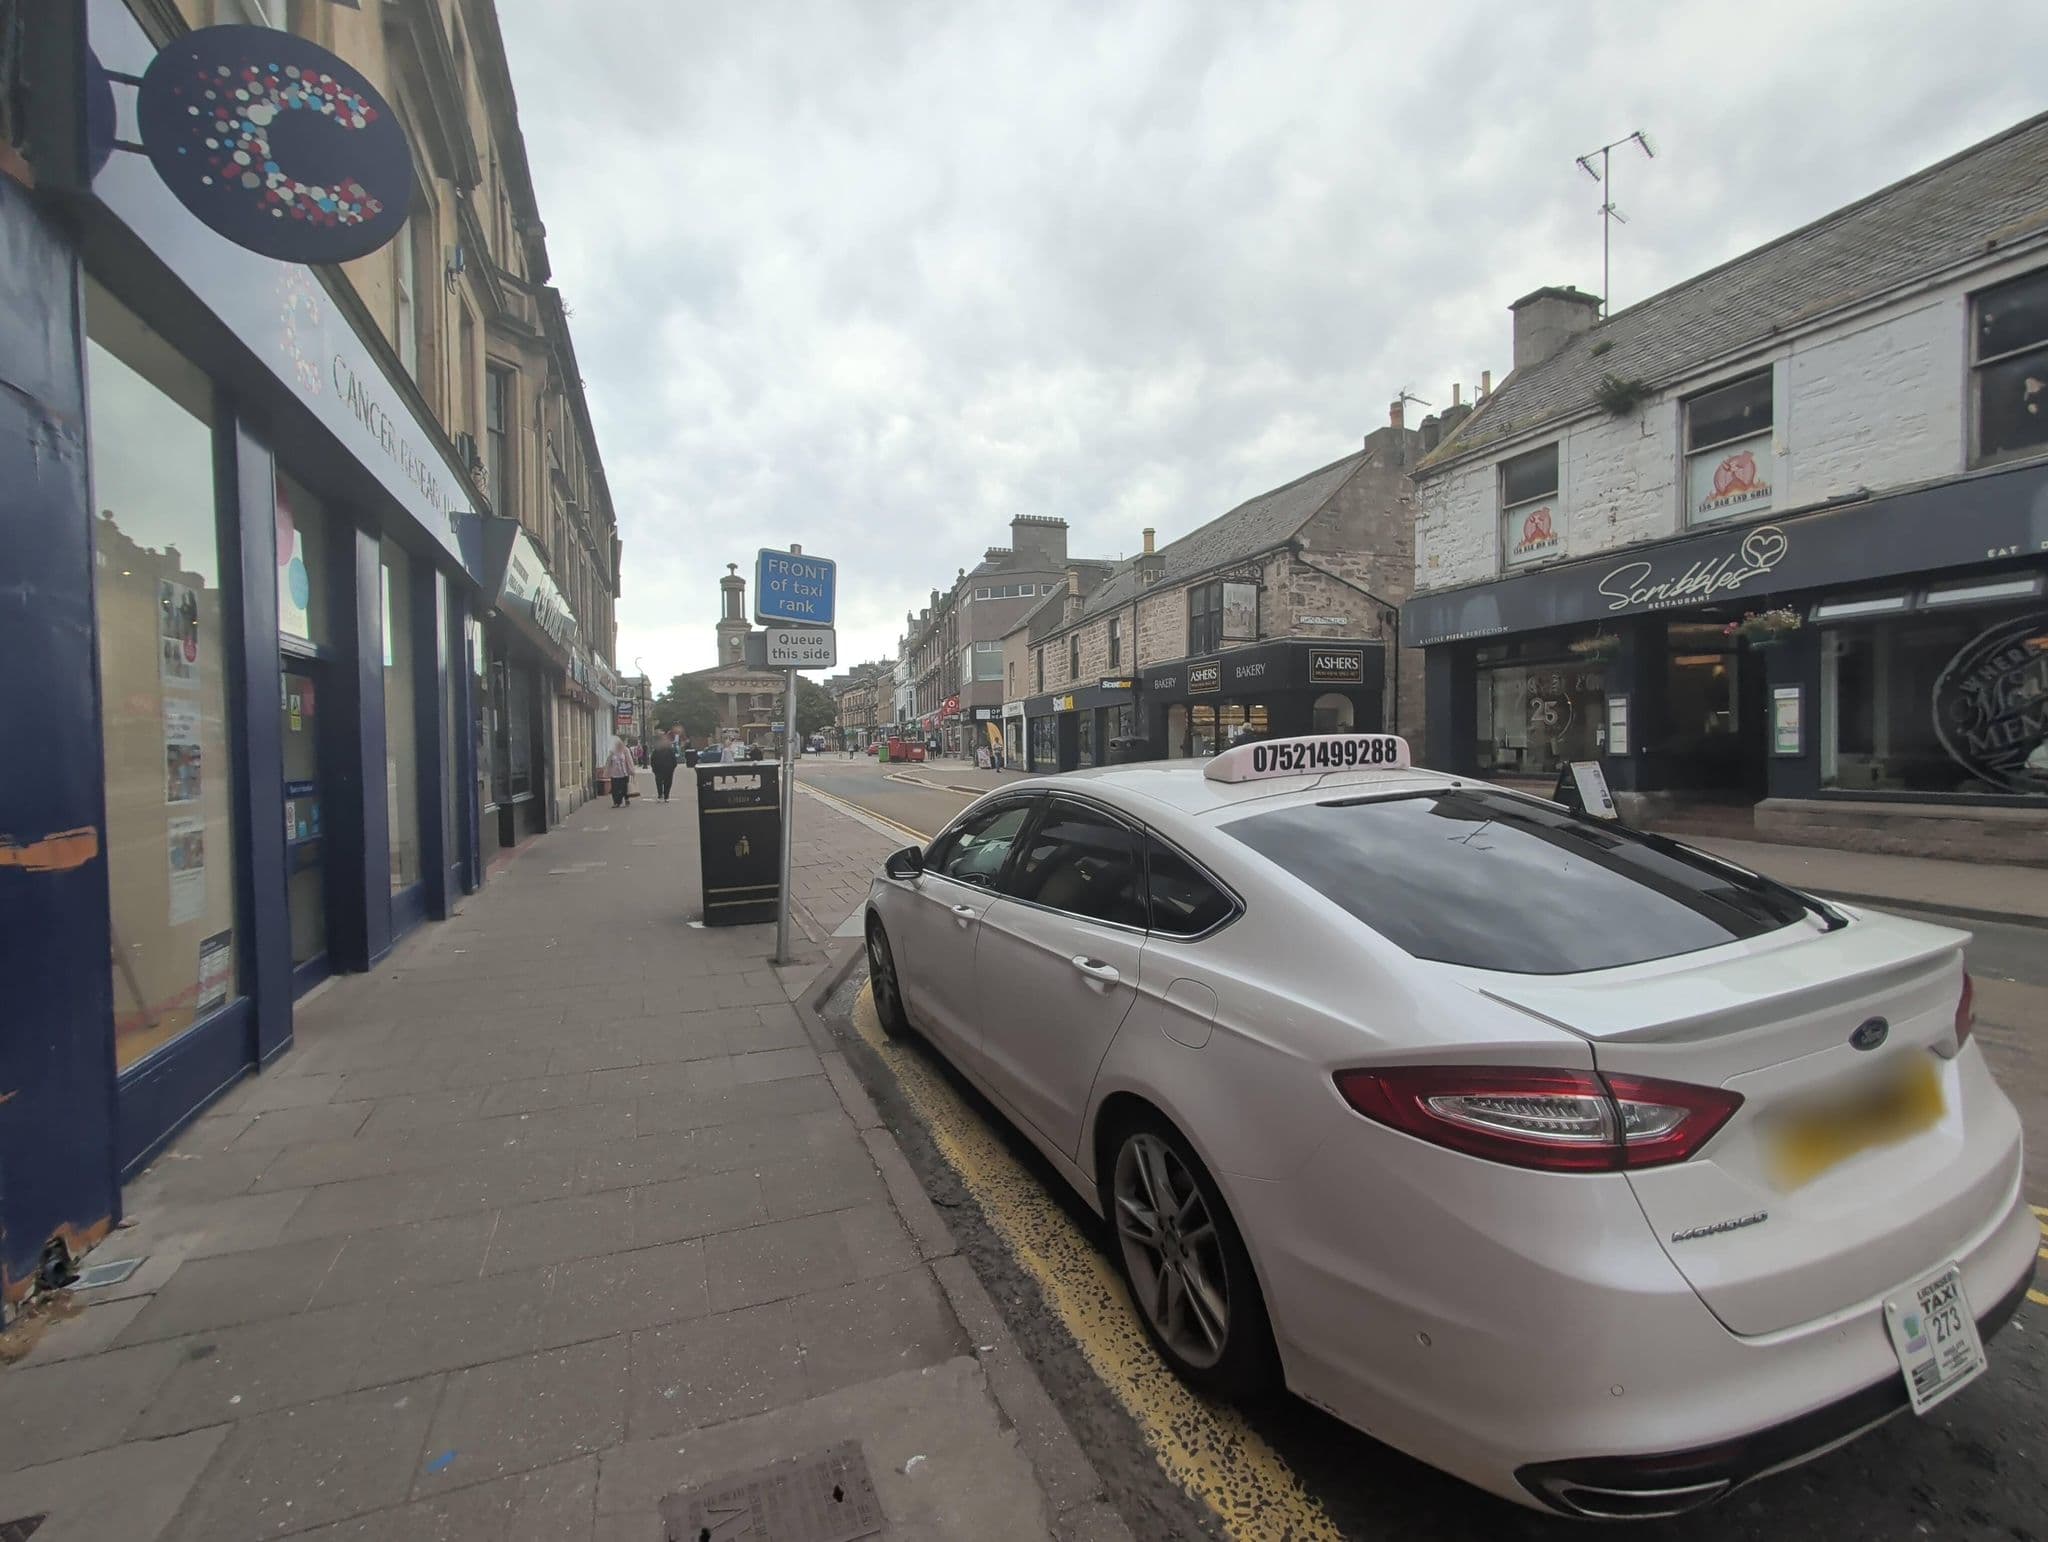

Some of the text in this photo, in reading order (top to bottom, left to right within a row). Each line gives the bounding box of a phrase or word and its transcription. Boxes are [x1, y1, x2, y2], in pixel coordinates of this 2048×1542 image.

[333, 354, 397, 462] CANCER
[1988, 545, 2017, 558] EAT
[768, 559, 828, 580] FRONT
[770, 579, 822, 597] of taxi
[1598, 553, 1770, 610] Scribbles
[779, 599, 815, 613] rank
[1648, 595, 1711, 609] RESTAURANT
[779, 634, 823, 645] Queue
[772, 648, 830, 659] this side
[1236, 663, 1267, 678] BAKERY
[1315, 657, 1359, 670] ASHERS
[1190, 667, 1217, 682] ASHERS
[1154, 677, 1177, 689] BAKERY
[1530, 697, 1559, 725] 25
[1253, 738, 1397, 772] 07521499288
[1920, 1283, 1960, 1314] TAXI
[1933, 1306, 1962, 1344] 273
